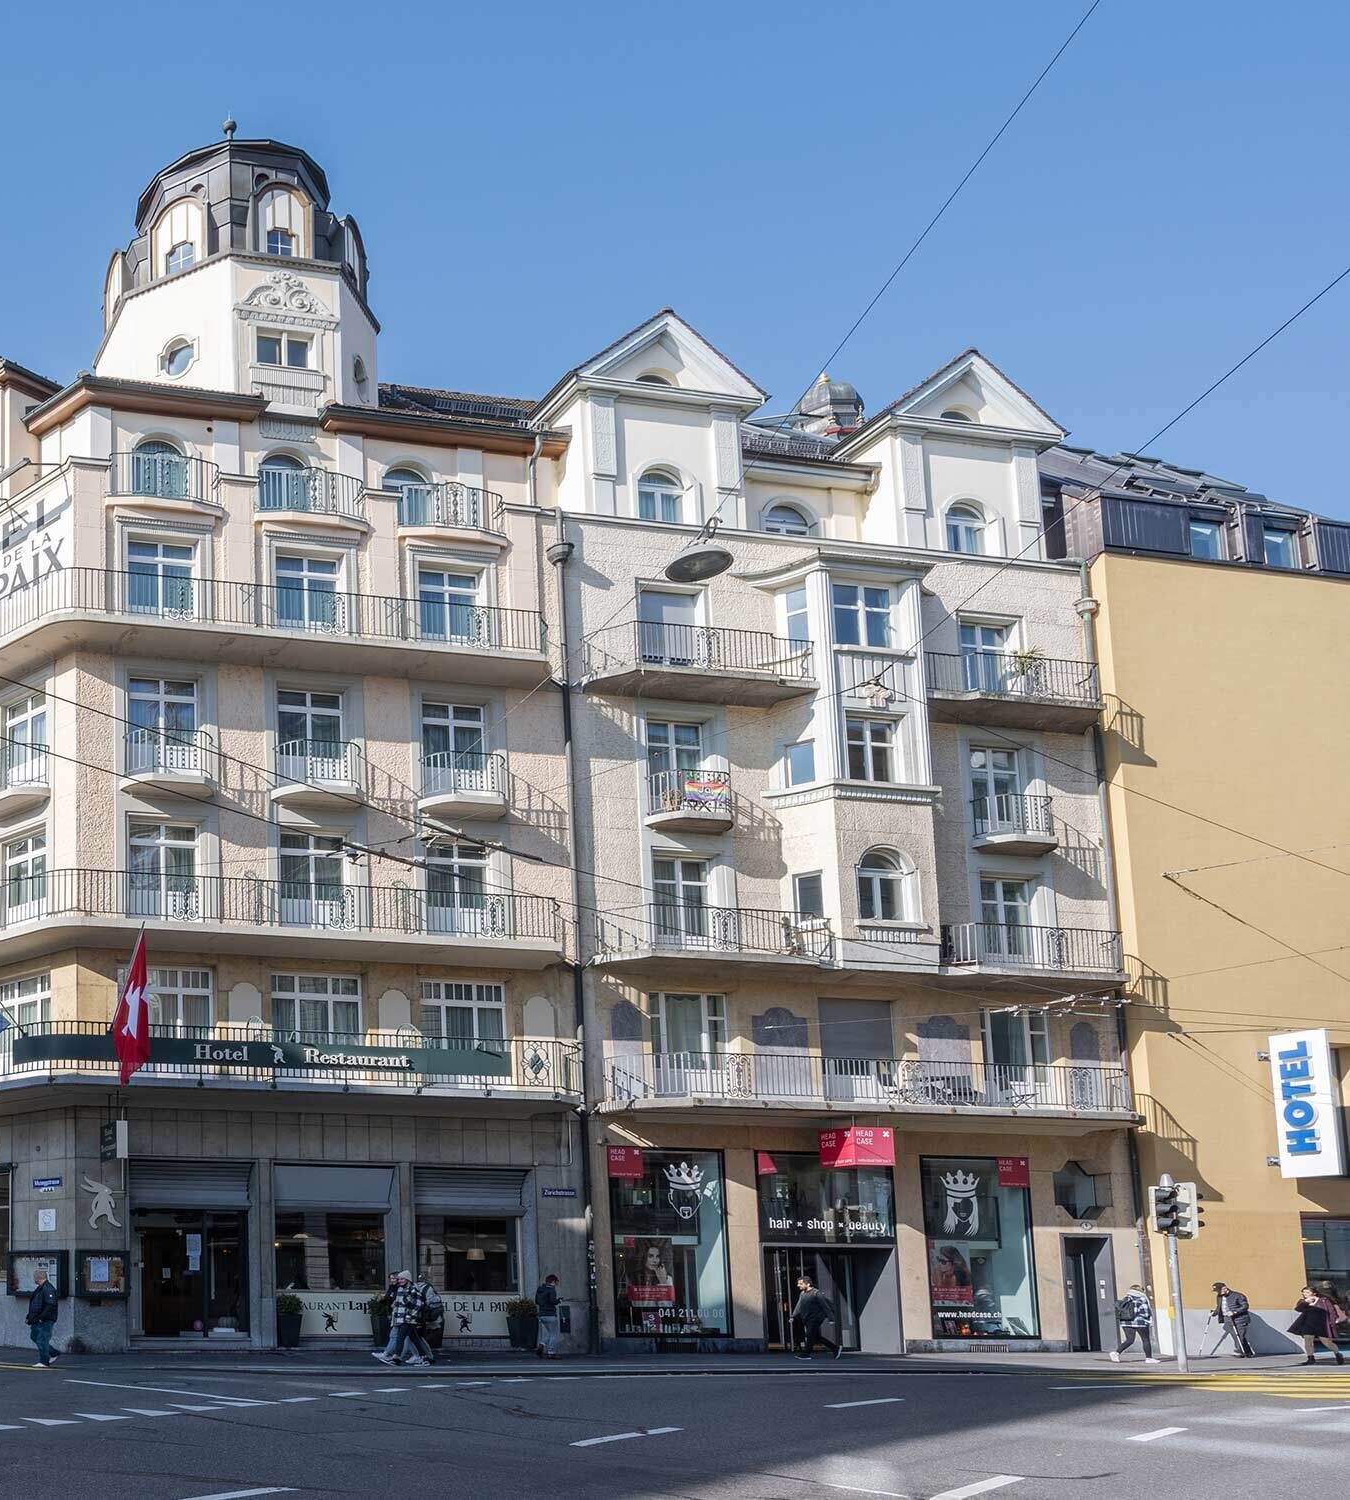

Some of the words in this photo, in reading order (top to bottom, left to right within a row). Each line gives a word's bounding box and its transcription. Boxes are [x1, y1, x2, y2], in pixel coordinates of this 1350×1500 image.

[3, 551, 22, 568] DE
[32, 532, 51, 550] LA
[194, 1044, 249, 1061] Hotel
[303, 1047, 410, 1067] Restaurant
[1278, 1041, 1318, 1154] HOTEL
[821, 1140, 837, 1148] CASE
[769, 1217, 792, 1229] hair
[807, 1218, 834, 1231] shop
[848, 1219, 887, 1232] beauty
[349, 1300, 371, 1314] Lap
[454, 1302, 469, 1311] DE
[473, 1302, 484, 1311] LA
[659, 1307, 676, 1318] 041
[679, 1308, 694, 1318] 211
[937, 1311, 1002, 1319] www.headcase.ch
